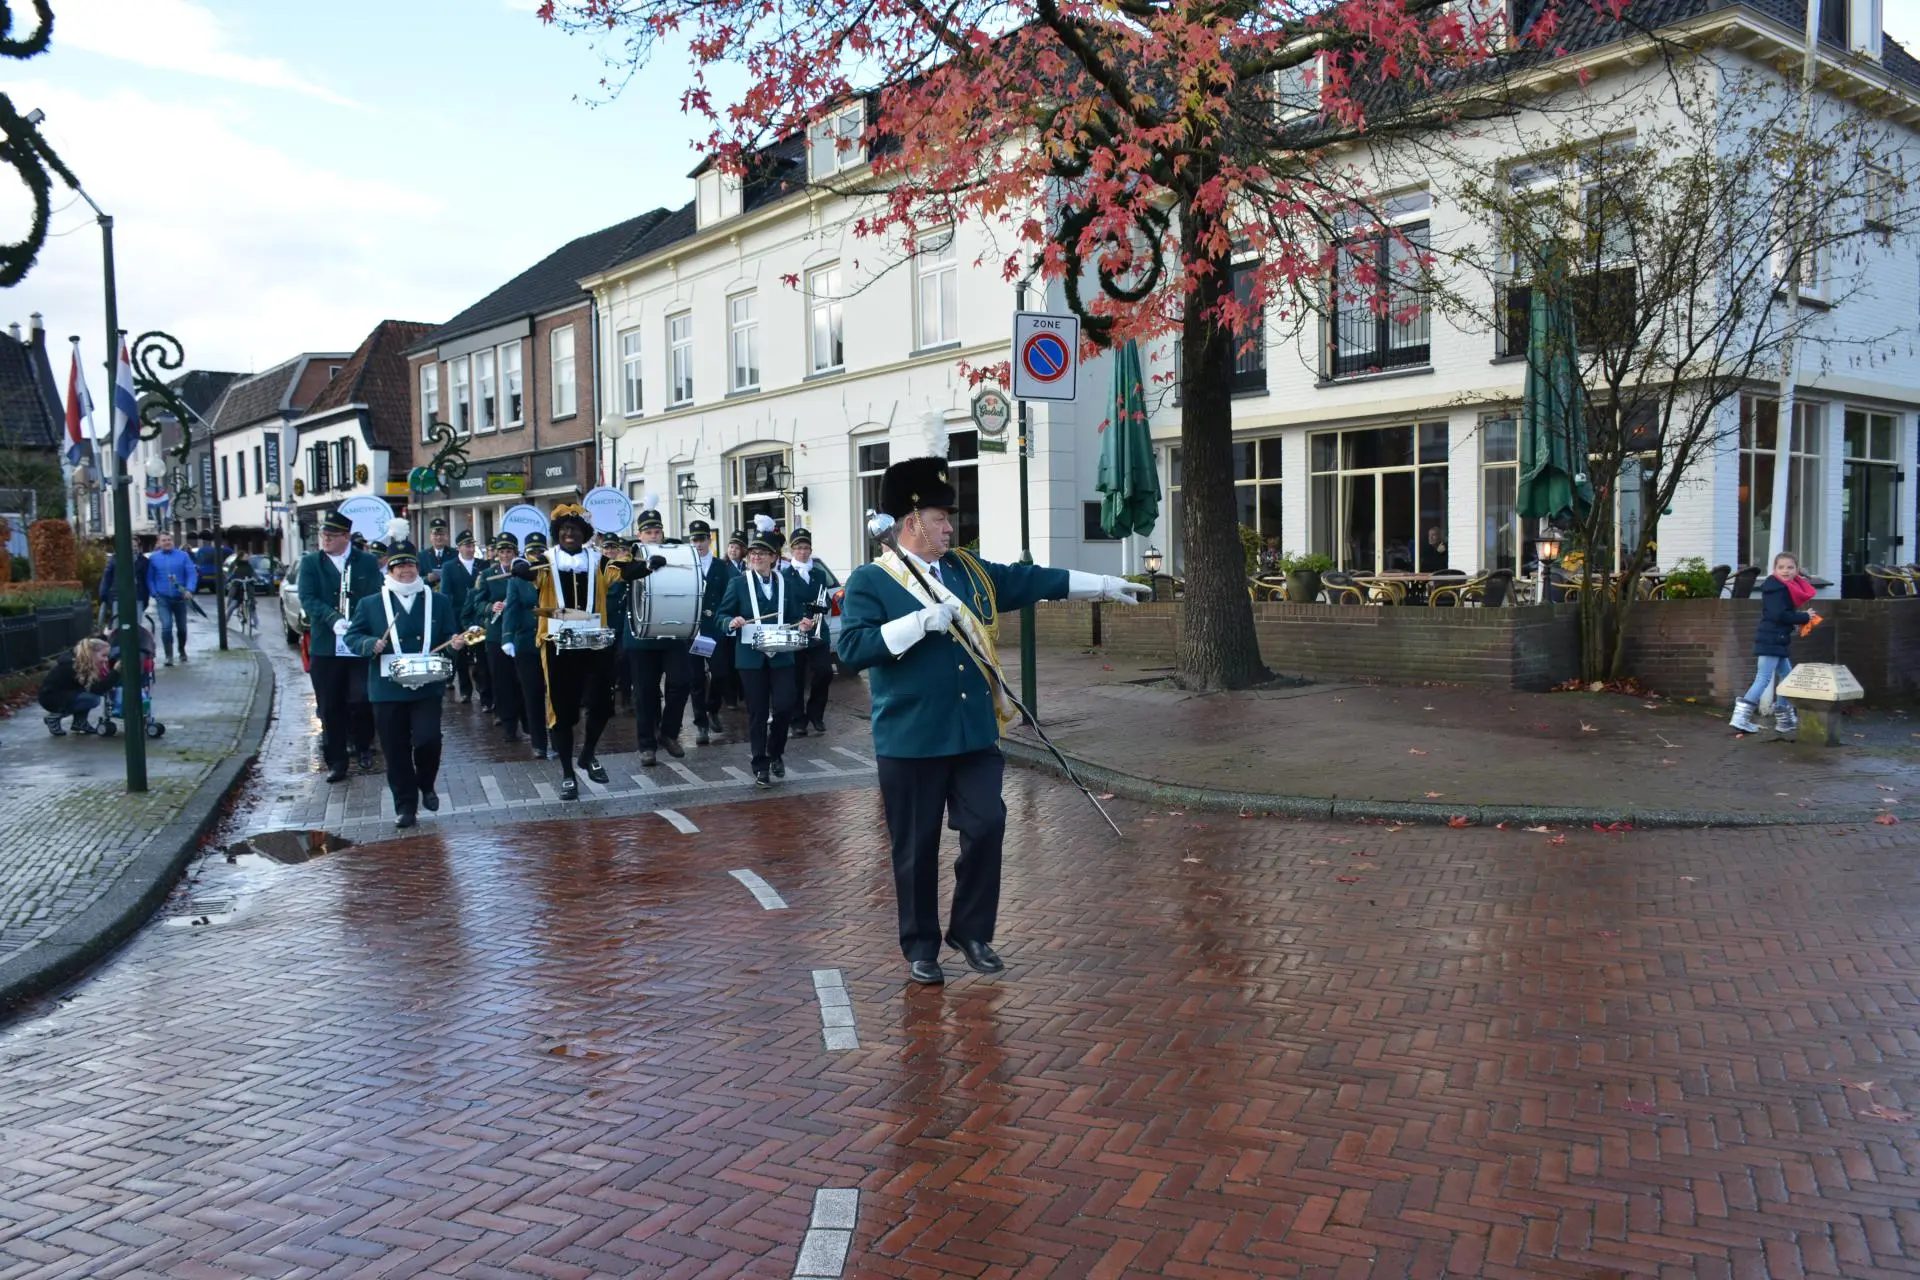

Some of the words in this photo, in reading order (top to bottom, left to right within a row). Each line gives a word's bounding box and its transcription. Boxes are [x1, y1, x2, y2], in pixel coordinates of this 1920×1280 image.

[1033, 319, 1061, 329] ZONE
[267, 441, 279, 483] SLAPEN
[204, 457, 213, 497] TEXTIEL
[589, 498, 622, 507] AMICITIA
[343, 505, 382, 515] AMICITIA
[508, 516, 541, 528] AMICITIA
